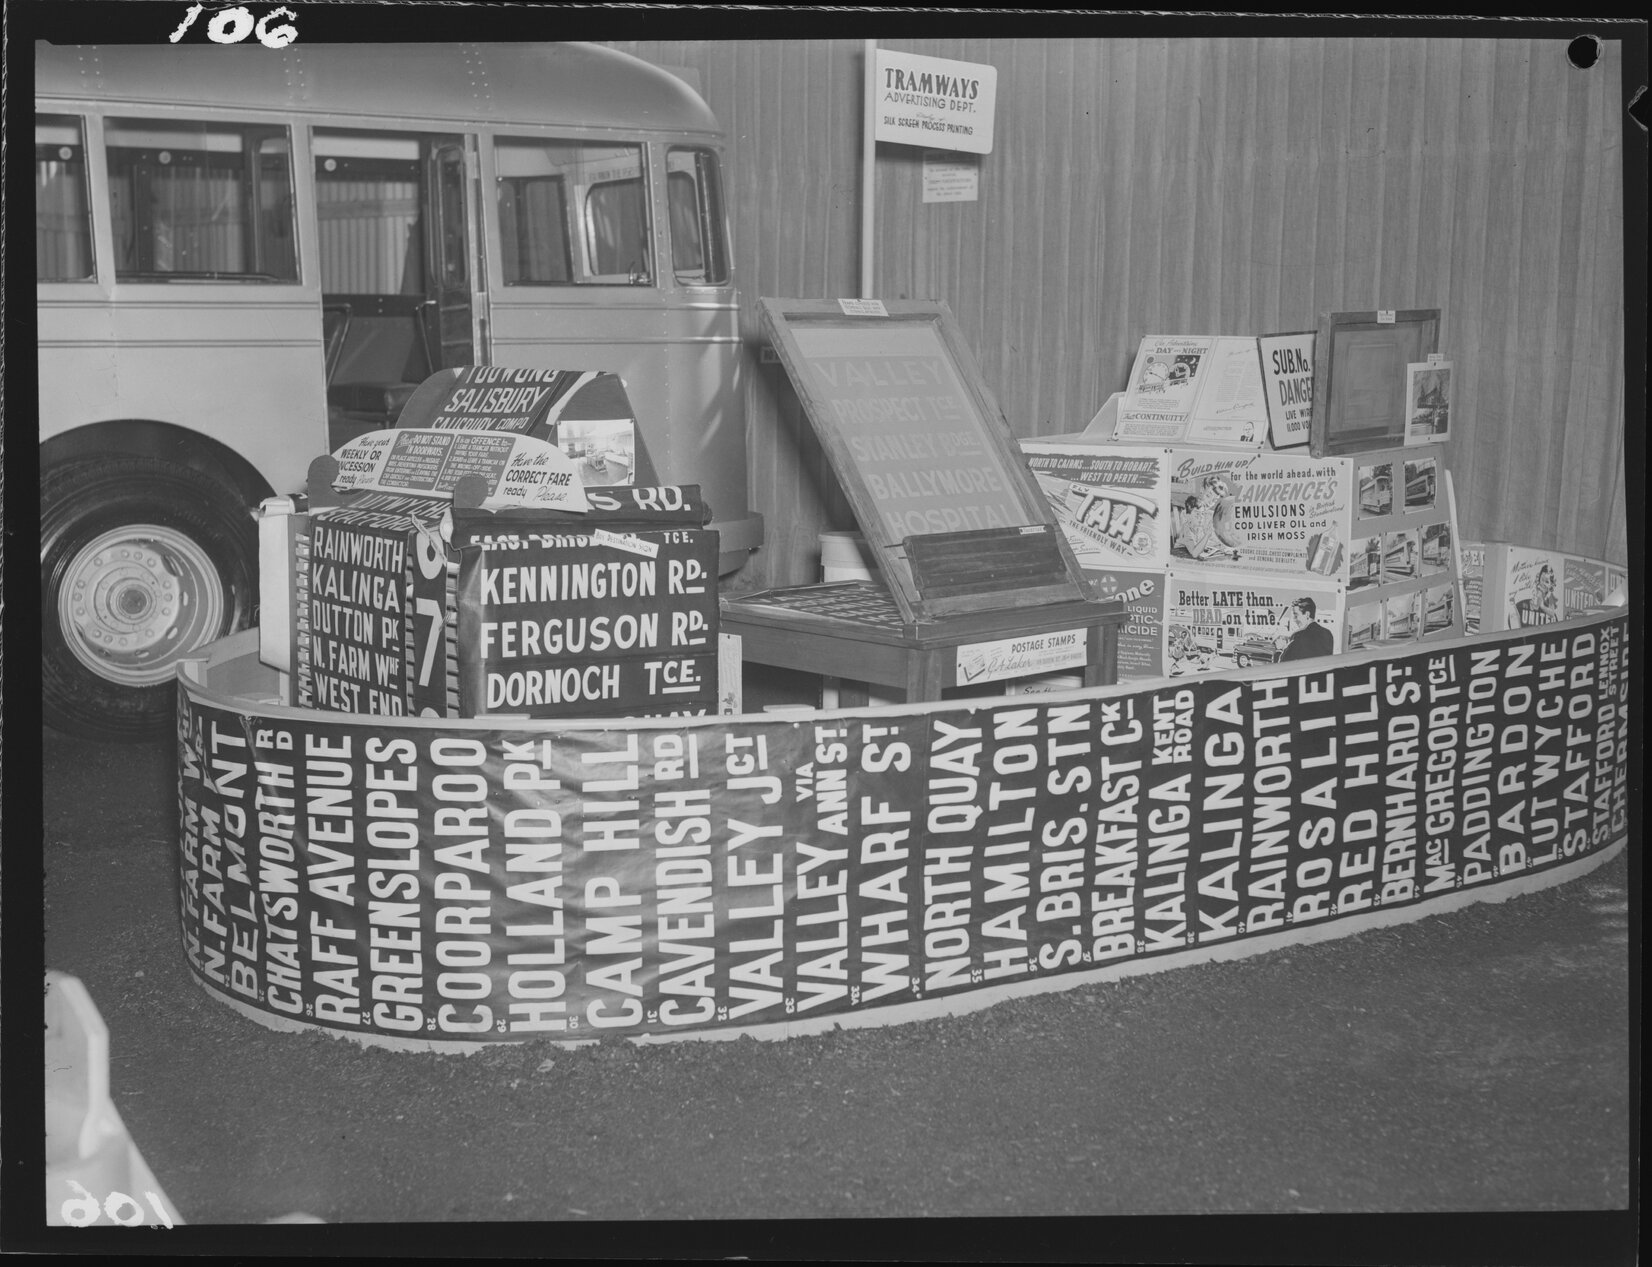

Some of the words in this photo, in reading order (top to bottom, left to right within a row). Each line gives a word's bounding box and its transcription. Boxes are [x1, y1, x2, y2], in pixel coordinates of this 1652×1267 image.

[884, 92, 946, 109] ADVERTISING
[950, 101, 976, 113] DEPT.
[885, 68, 979, 100] TRAMWAYS
[884, 116, 895, 126] SILK
[898, 118, 919, 129] SCREEN
[922, 120, 945, 132] PROCESS
[947, 123, 973, 135] PRINTING
[815, 360, 944, 386] VALLEY
[444, 387, 551, 413] SALISBURY
[831, 397, 928, 423] PROSPECT
[1285, 409, 1297, 420] LIVE
[340, 449, 369, 460] WEEKLY
[369, 450, 382, 461] OR
[471, 437, 501, 446] OFFENCE
[511, 452, 532, 467] Have
[533, 451, 550, 467] the
[852, 434, 938, 462] STANLEY
[1028, 457, 1050, 469] NORTH
[1049, 458, 1058, 469] TO
[1113, 461, 1124, 471] TO
[339, 474, 357, 487] ready
[505, 469, 547, 485] CORRECT
[547, 472, 573, 487] FARE
[868, 468, 1002, 500] BALLYMORE
[1102, 472, 1113, 482] TO
[1178, 458, 1212, 478] BUILD
[1214, 460, 1234, 471] HIM
[1235, 456, 1256, 469] UP!
[1230, 470, 1241, 481] for
[1246, 470, 1258, 480] the
[1261, 467, 1283, 480] world
[1316, 467, 1336, 478] with
[1235, 477, 1338, 503] LAWRENCE'S
[503, 487, 528, 499] ready
[532, 486, 569, 502] Please
[1069, 482, 1158, 545] TAA
[1235, 503, 1306, 519] EMULSIONS
[663, 532, 694, 544] TCE.
[887, 504, 1010, 533] HOSPITAL
[1069, 520, 1079, 529] THE
[1080, 524, 1109, 545] FRIENDLY
[1109, 538, 1127, 556] WAY
[1234, 522, 1254, 530] COD
[1257, 521, 1286, 530] LIVER
[1290, 520, 1307, 528] OIL
[1310, 520, 1326, 528] and
[1247, 532, 1273, 541] IRISH
[1277, 531, 1306, 540] MOSS
[313, 526, 404, 574] RAINWORTH
[313, 563, 401, 613] KALINGA
[481, 561, 656, 605] KENNINGTON
[1179, 590, 1209, 606] Better
[1213, 591, 1243, 606] LATE
[1565, 588, 1594, 611] UNITED
[313, 599, 374, 645] DUTTON
[1127, 605, 1158, 614] LIQUID
[1227, 614, 1241, 625] on
[1245, 607, 1289, 626] time!
[416, 597, 444, 687] 7
[481, 612, 659, 659] FERGUSON
[1011, 639, 1044, 654] POSTAGE
[1048, 634, 1076, 649] STAMPS
[329, 640, 371, 682] FARM
[1599, 627, 1609, 699] LENNOX
[1607, 625, 1621, 697] STREET
[314, 672, 360, 714] WEST
[369, 689, 403, 718] END
[487, 664, 620, 709] DORNOCH
[1048, 705, 1091, 794] STN
[1152, 696, 1174, 764] KENT
[1171, 690, 1194, 763] ROAD
[1343, 667, 1378, 788] HILL
[1564, 634, 1594, 856] STAFFORD
[1462, 649, 1500, 884] PADDINGTON
[1498, 644, 1538, 875] BARDON
[1531, 639, 1570, 865] LUTWYCHE
[1593, 704, 1618, 844] STAFFORD
[579, 733, 643, 851] HILL
[796, 762, 813, 801] VIA
[928, 720, 982, 833] QUAY
[1291, 673, 1337, 922] ROSALIE
[306, 735, 355, 905] AVENUE
[816, 770, 847, 835] ANN
[1198, 687, 1245, 941] KALINGA
[1247, 679, 1292, 932] RAINWORTH
[1381, 715, 1419, 904] BERNHARD
[212, 721, 258, 999] BELMONT
[982, 709, 1038, 979] HAMILTON
[1092, 757, 1139, 960] BREAKFAST
[1144, 774, 1193, 951] KALINGA
[1338, 810, 1379, 913] RED
[255, 762, 302, 1013] CHATSWORTH
[364, 738, 423, 1030] GREENSLOPES
[430, 739, 495, 1032] COORPAROO
[655, 790, 715, 1025] CAVENDISH
[859, 797, 910, 1001] WHARF
[504, 808, 569, 1032] HOLLAND
[727, 819, 783, 1019] VALLEY
[796, 842, 848, 1011] VALLEY
[924, 846, 973, 990] NORTH
[310, 911, 360, 1024] RAFF
[584, 877, 642, 1027] CAMP
[1028, 957, 1038, 972] 36
[972, 970, 982, 982] 35
